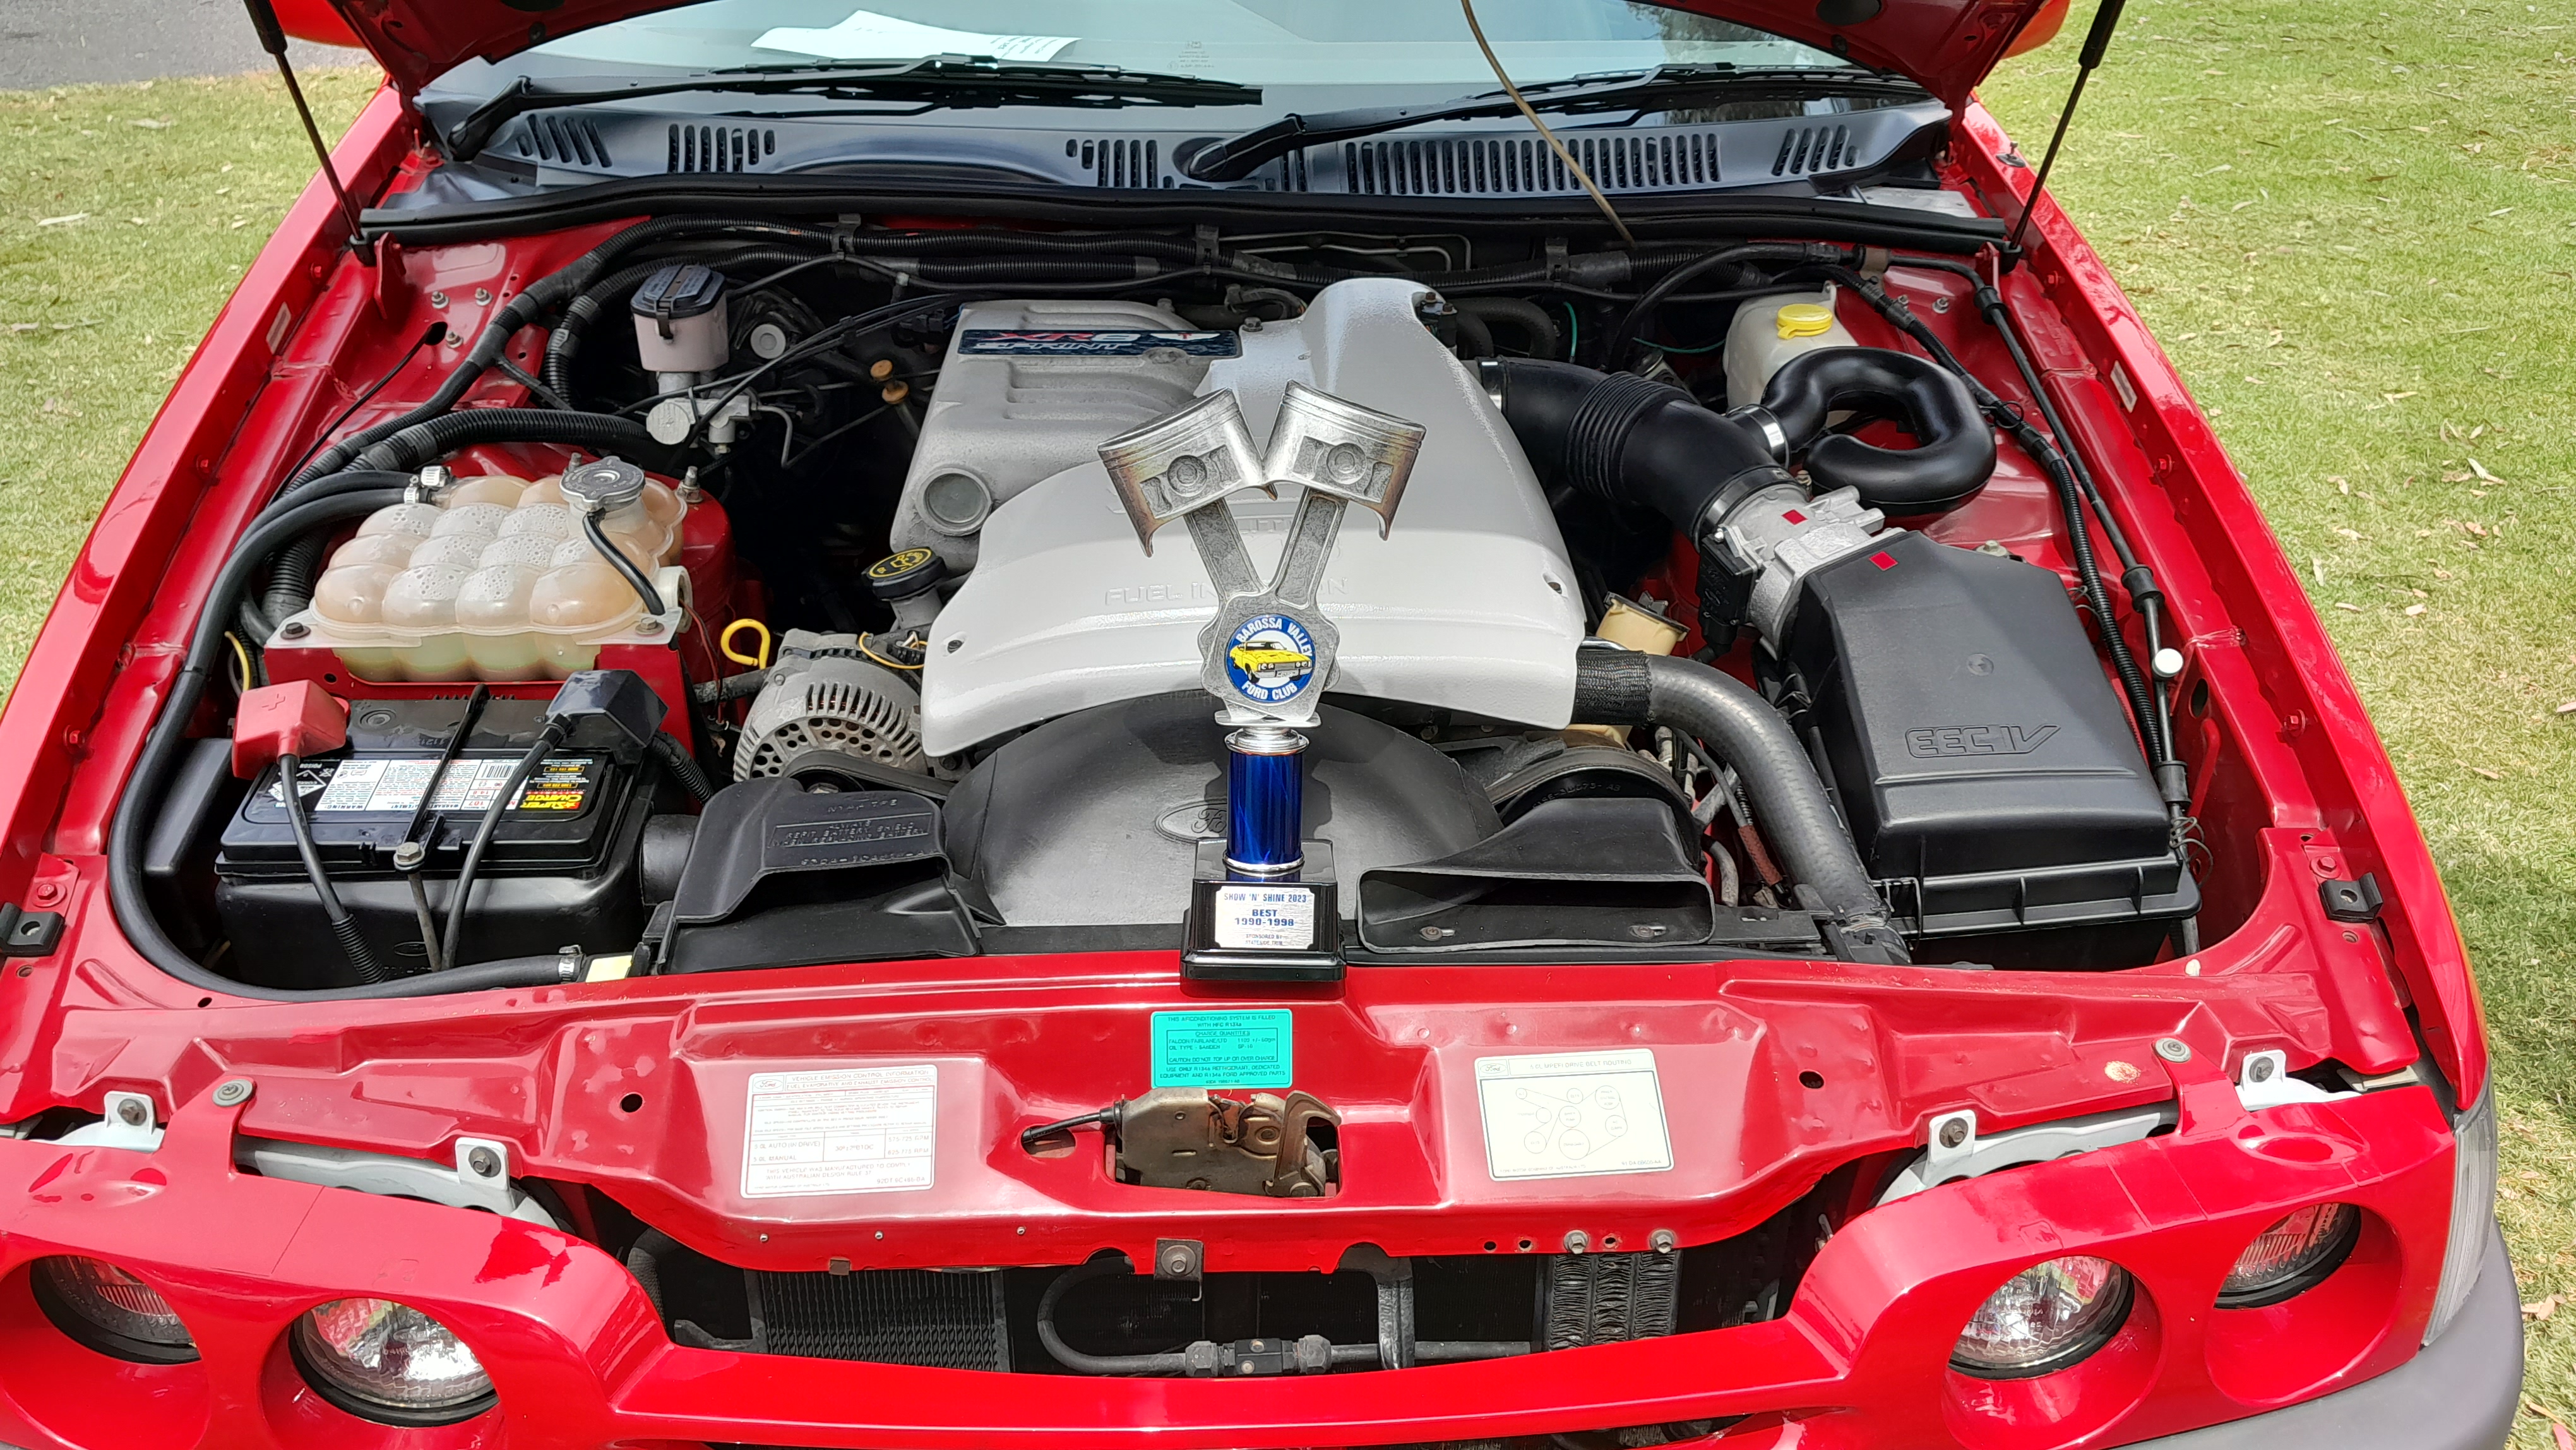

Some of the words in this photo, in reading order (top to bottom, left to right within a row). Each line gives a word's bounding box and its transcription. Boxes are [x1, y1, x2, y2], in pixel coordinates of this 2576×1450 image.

[981, 332, 1141, 342] XR8
[1105, 584, 1183, 606] FUEL
[1236, 618, 1282, 642] BAROSSA
[1287, 622, 1313, 657] VALLEY
[1241, 680, 1268, 700] FORD
[1272, 683, 1298, 700] CLUB
[1191, 808, 1227, 834] Fo
[1224, 892, 1246, 901] SHOW
[1263, 893, 1285, 902] SHINE
[1288, 894, 1307, 902] 2023
[1252, 909, 1278, 917] BEST
[1234, 918, 1294, 926] 1990-1998
[1485, 1064, 1501, 1072] Ford
[760, 1079, 777, 1088] Ford
